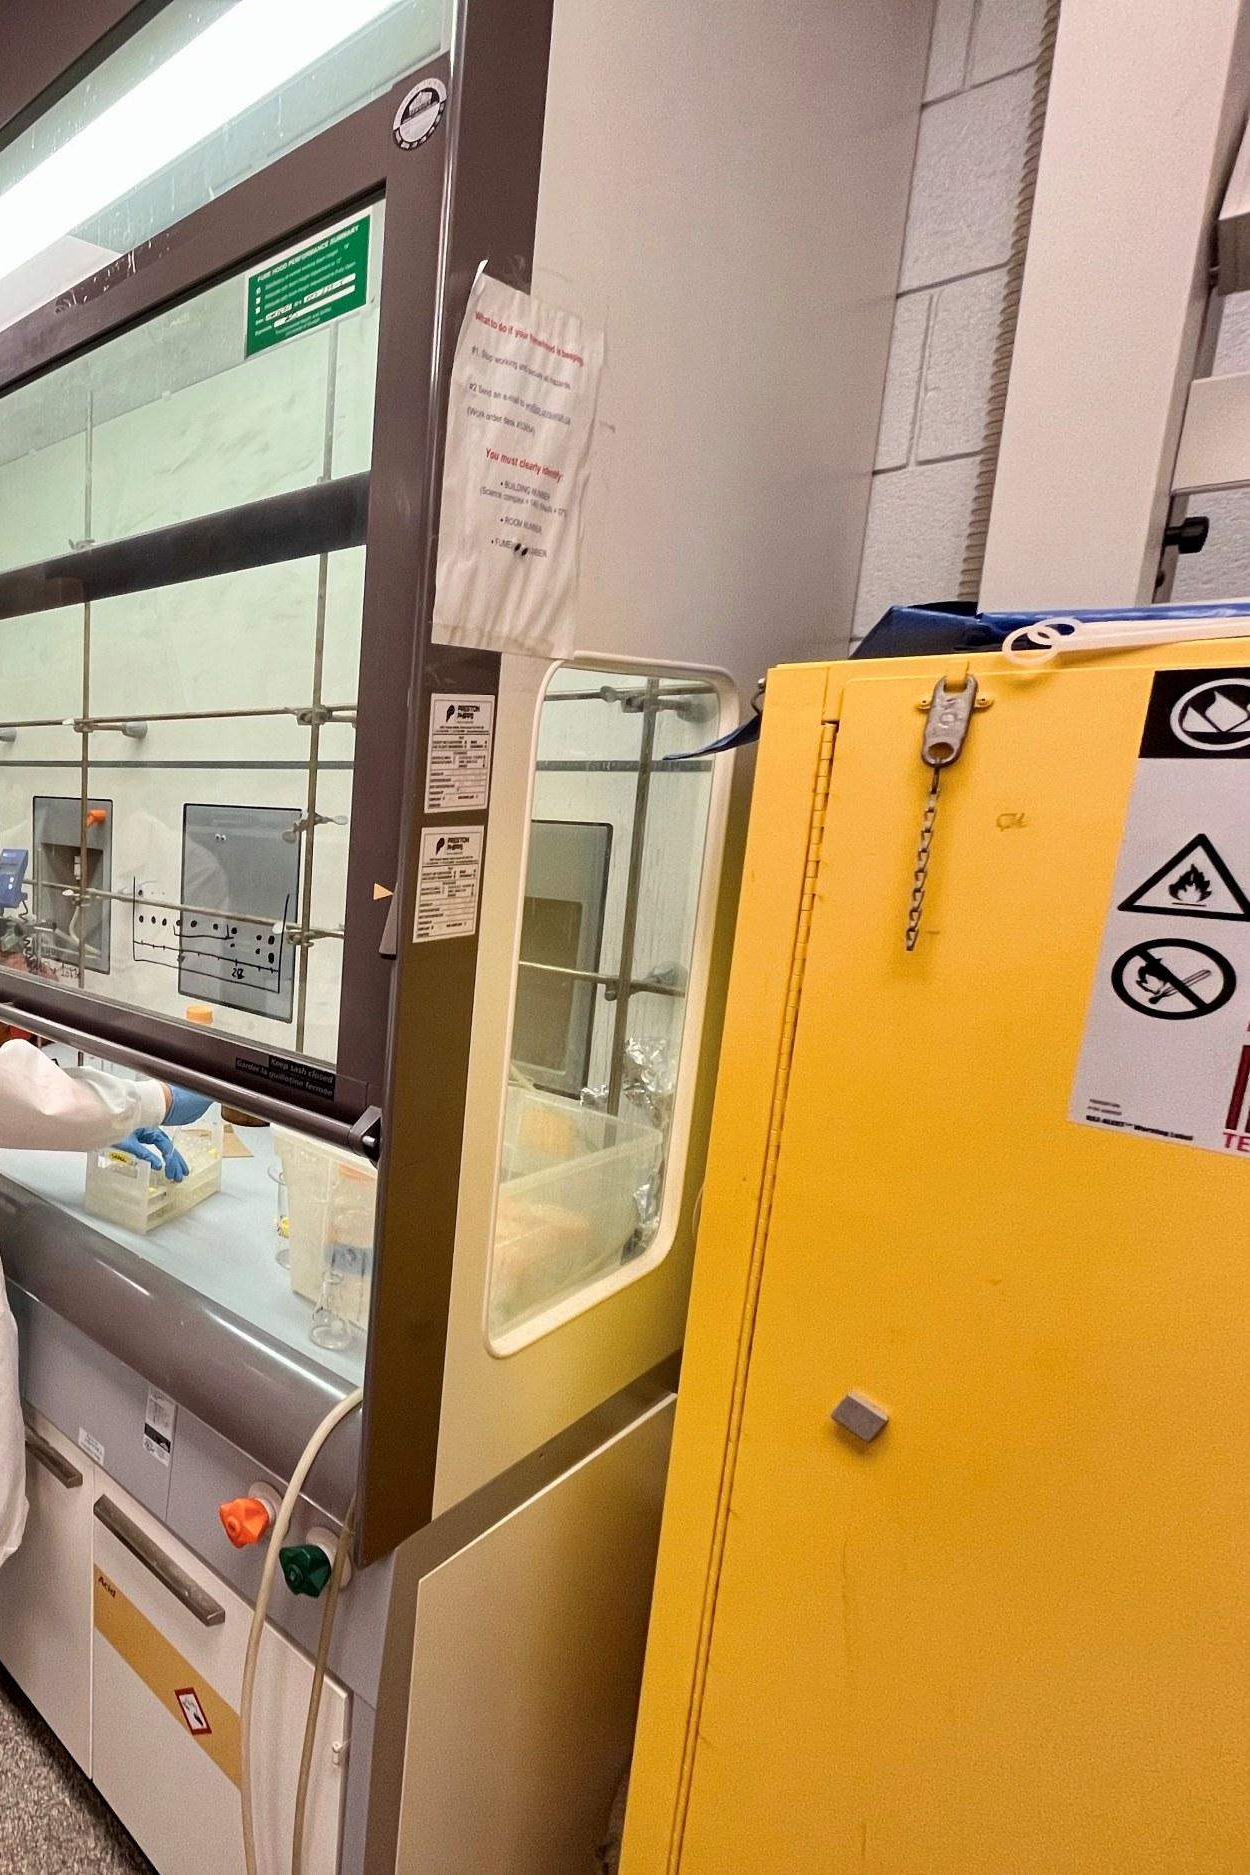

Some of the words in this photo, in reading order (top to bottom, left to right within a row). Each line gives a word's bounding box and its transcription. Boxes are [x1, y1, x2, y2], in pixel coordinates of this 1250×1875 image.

[288, 240, 329, 266] PERFORMANCE
[498, 322, 507, 333] do
[485, 447, 499, 460] You
[500, 453, 519, 467] must
[519, 459, 542, 476] clearly
[236, 1060, 260, 1072] Garder
[261, 1067, 267, 1075] la
[269, 1071, 304, 1087] guillotine
[271, 1058, 289, 1070] Keep
[290, 1065, 307, 1075] sash
[308, 1069, 334, 1083] closed
[98, 1576, 116, 1599] Acid
